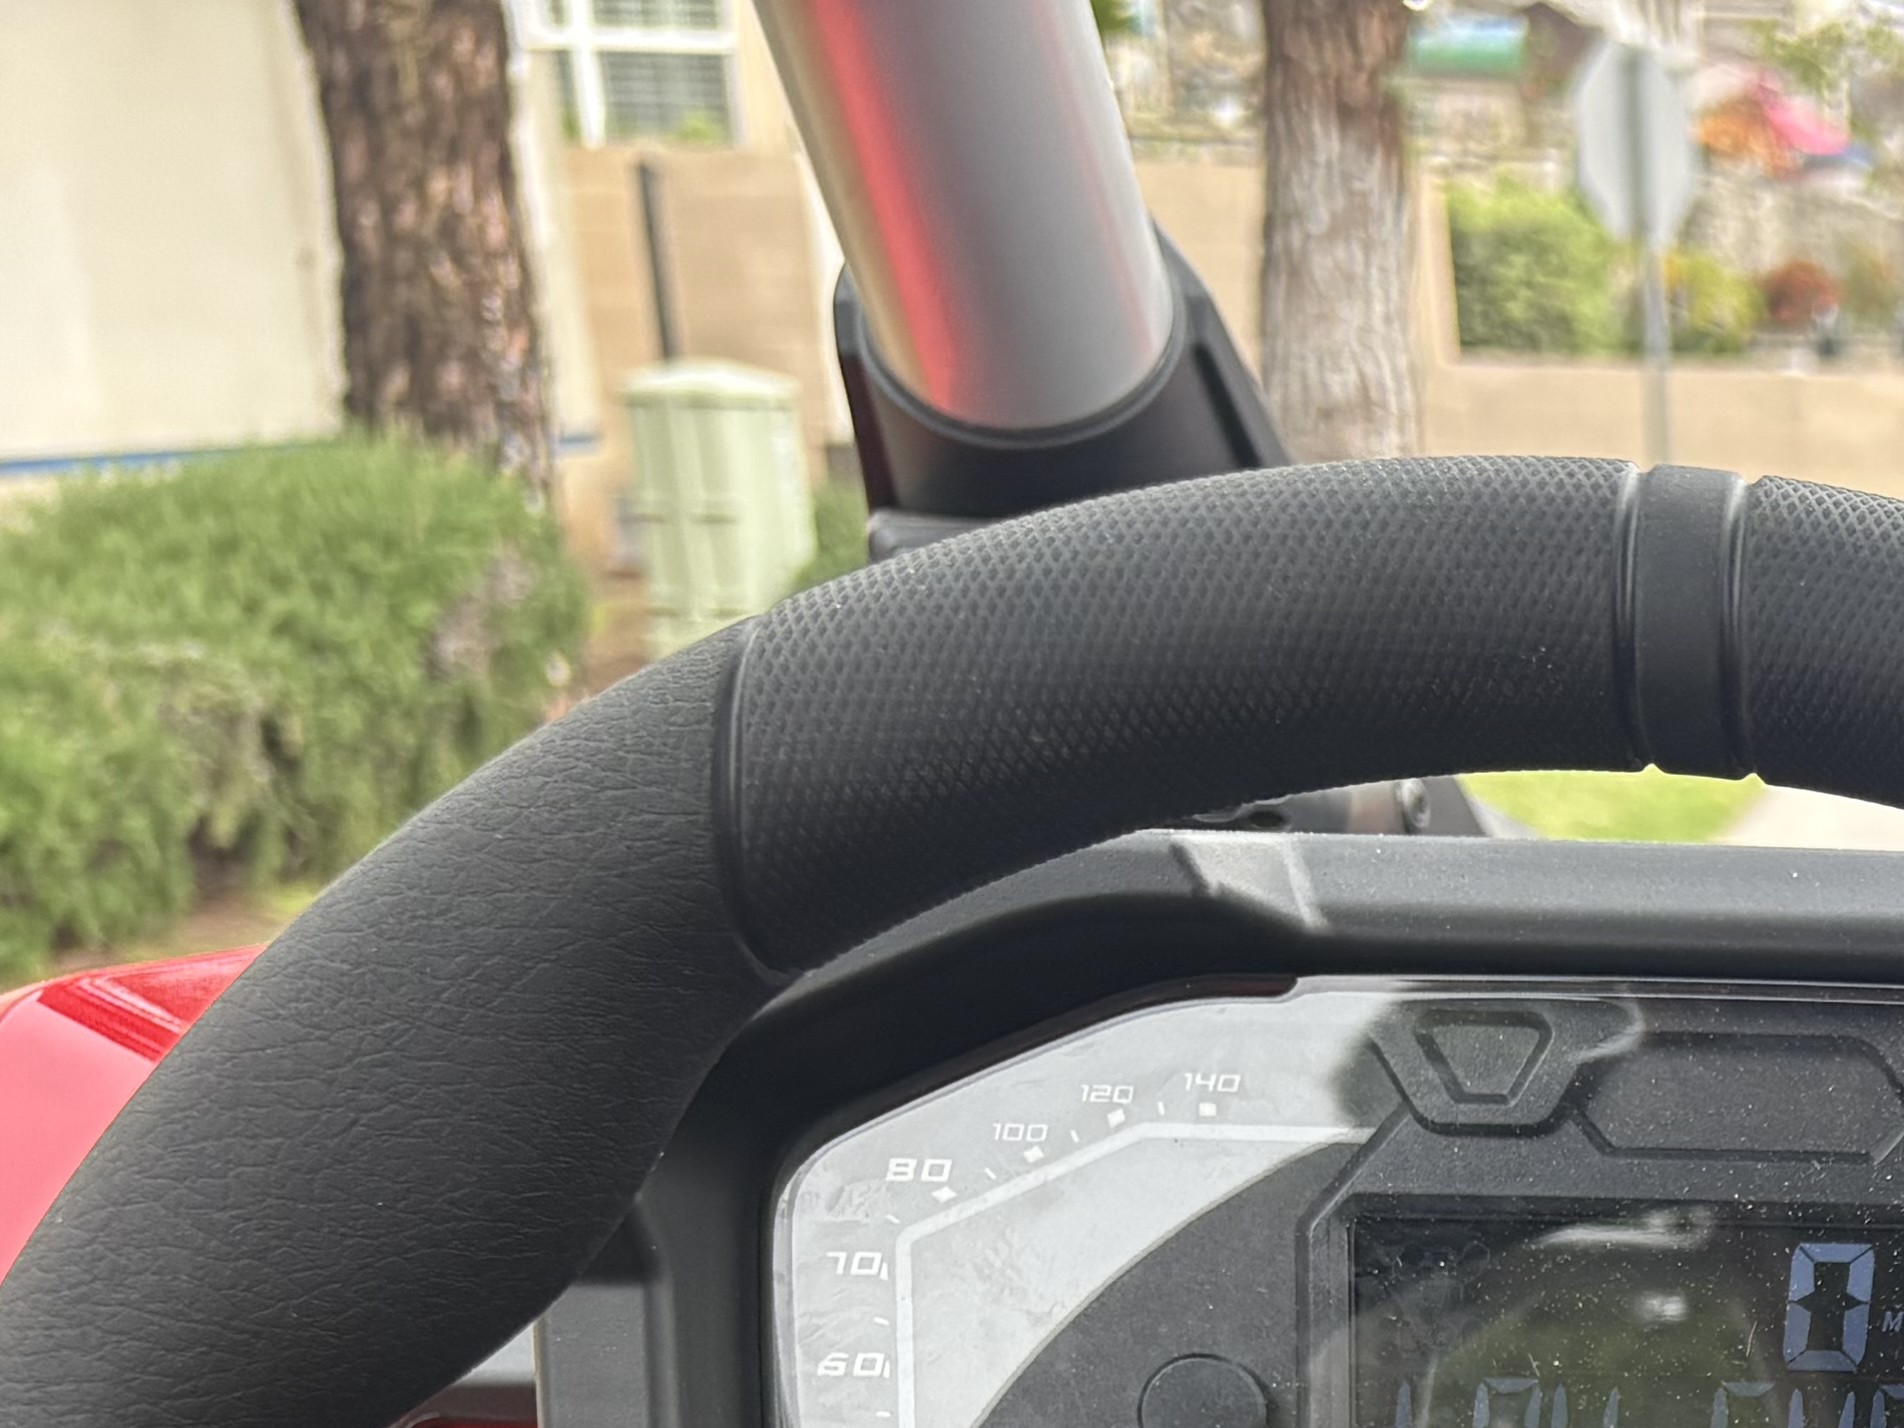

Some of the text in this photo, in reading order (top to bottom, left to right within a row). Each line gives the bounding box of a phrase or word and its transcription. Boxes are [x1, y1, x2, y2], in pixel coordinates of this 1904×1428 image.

[1080, 1084, 1135, 1105] 120
[1182, 1072, 1241, 1094] 140
[992, 1123, 1048, 1143] 100
[885, 1158, 953, 1183] 80
[826, 1252, 881, 1276] 70
[1781, 1242, 1876, 1373] 0
[816, 1351, 884, 1378] 60
